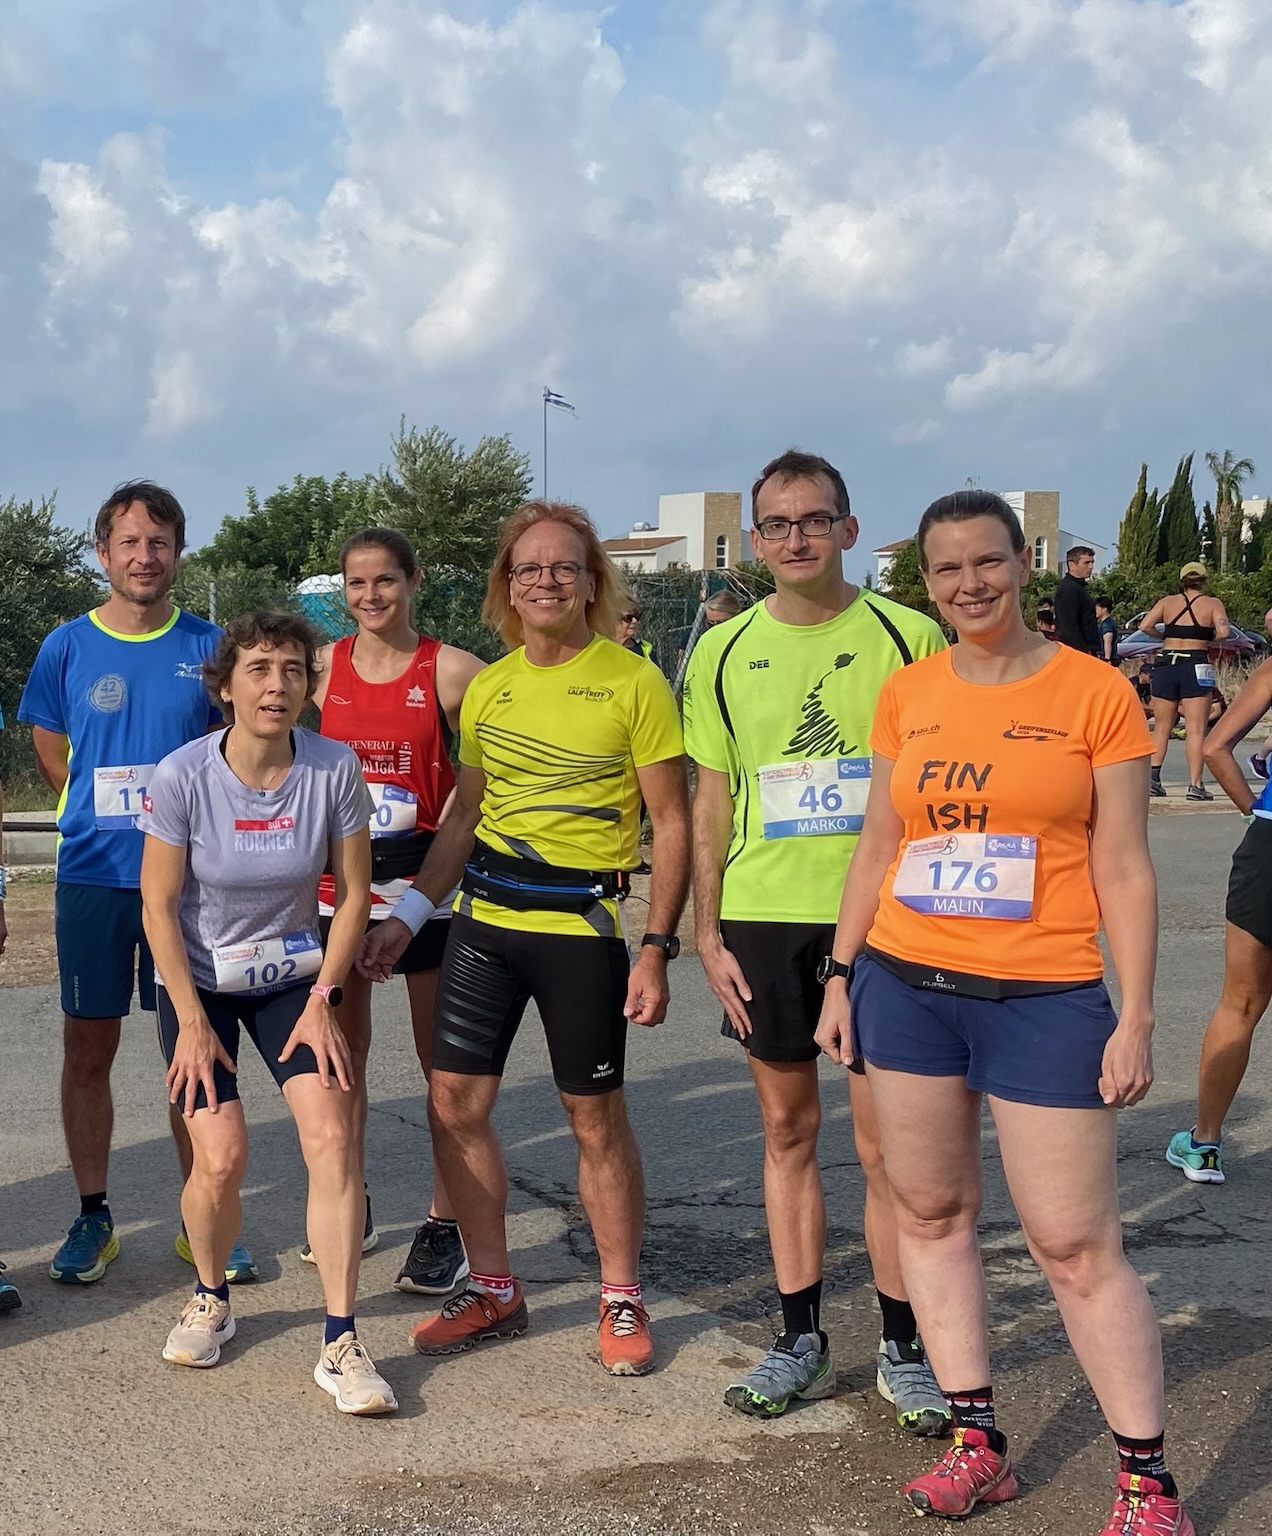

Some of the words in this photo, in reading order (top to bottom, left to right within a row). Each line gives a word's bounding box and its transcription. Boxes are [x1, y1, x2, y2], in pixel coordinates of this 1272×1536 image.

[749, 660, 769, 670] DEE
[100, 681, 117, 696] 42
[347, 740, 395, 750] GENERALI
[917, 760, 994, 793] FIN
[798, 784, 843, 813] 46
[376, 804, 392, 827] 0
[926, 803, 989, 832] ISH
[268, 820, 281, 829] SUI
[797, 818, 848, 833] MARKO
[234, 832, 296, 852] RUNNER
[929, 861, 998, 892] 176
[933, 898, 984, 914] MALIN
[245, 959, 297, 986] 102
[250, 983, 286, 996] KARIN
[922, 980, 957, 989] FLIPBELT
